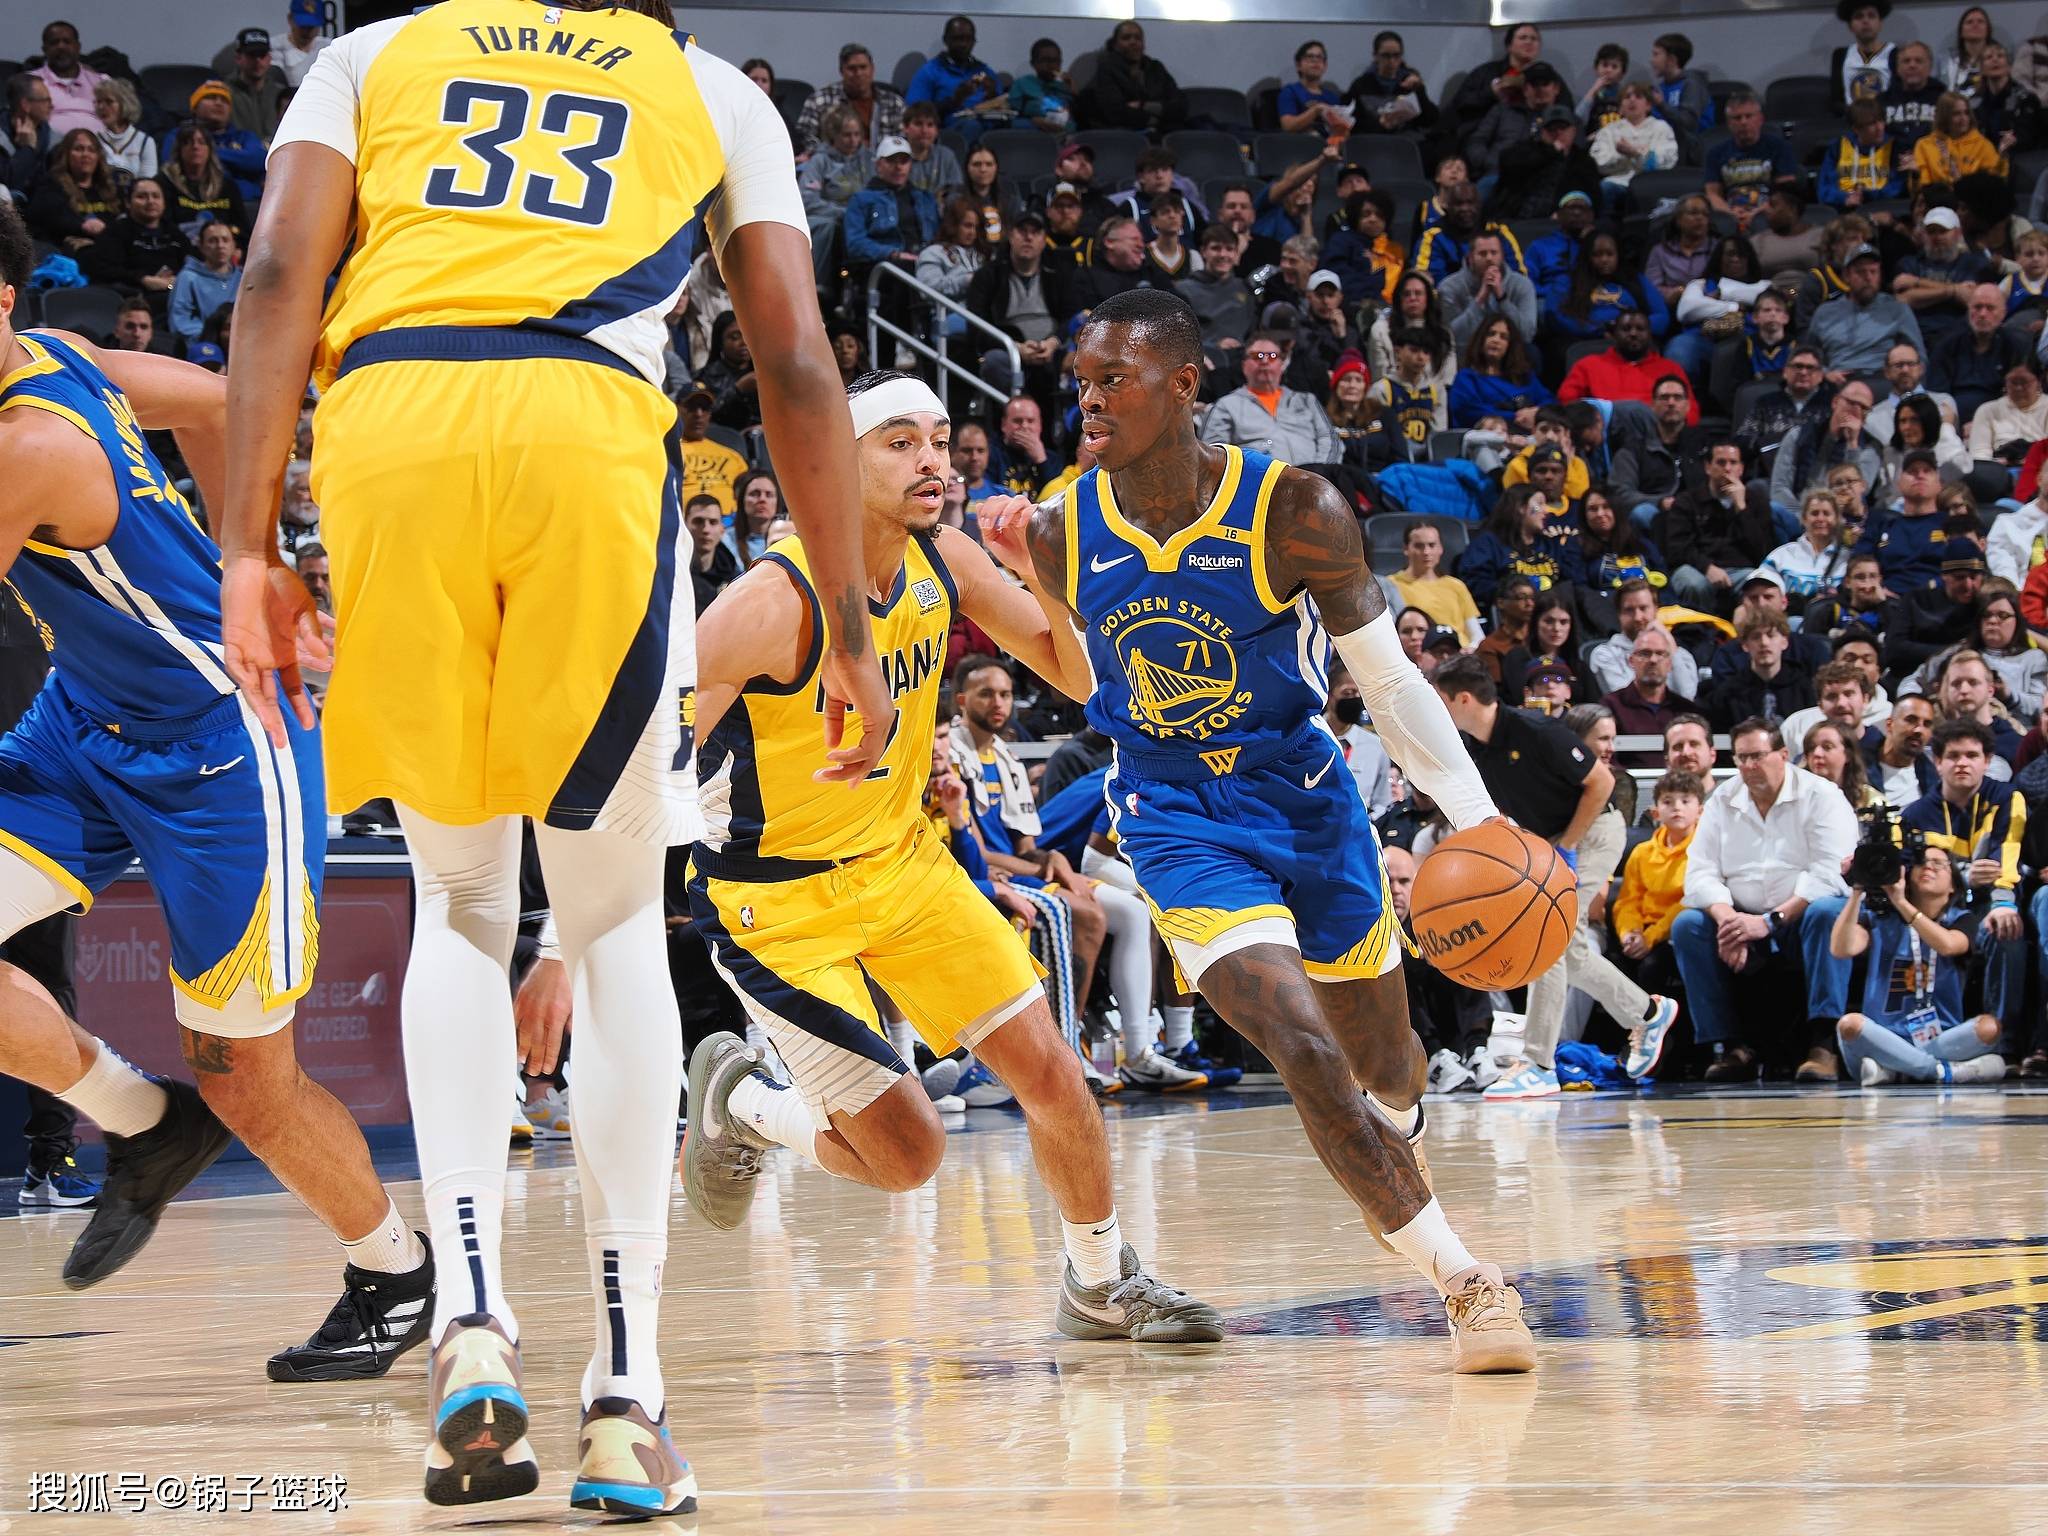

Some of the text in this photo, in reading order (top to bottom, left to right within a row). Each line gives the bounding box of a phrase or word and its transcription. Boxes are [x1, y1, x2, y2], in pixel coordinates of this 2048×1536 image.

[460, 25, 633, 71] TURNER
[424, 77, 631, 227] 33
[1224, 528, 1238, 539] 16
[1188, 554, 1243, 568] Rakuten
[1100, 597, 1233, 640] GOLDEN STATE
[1175, 639, 1212, 671] 71
[105, 926, 161, 982] mhs
[304, 1015, 372, 1043] COVERED.
